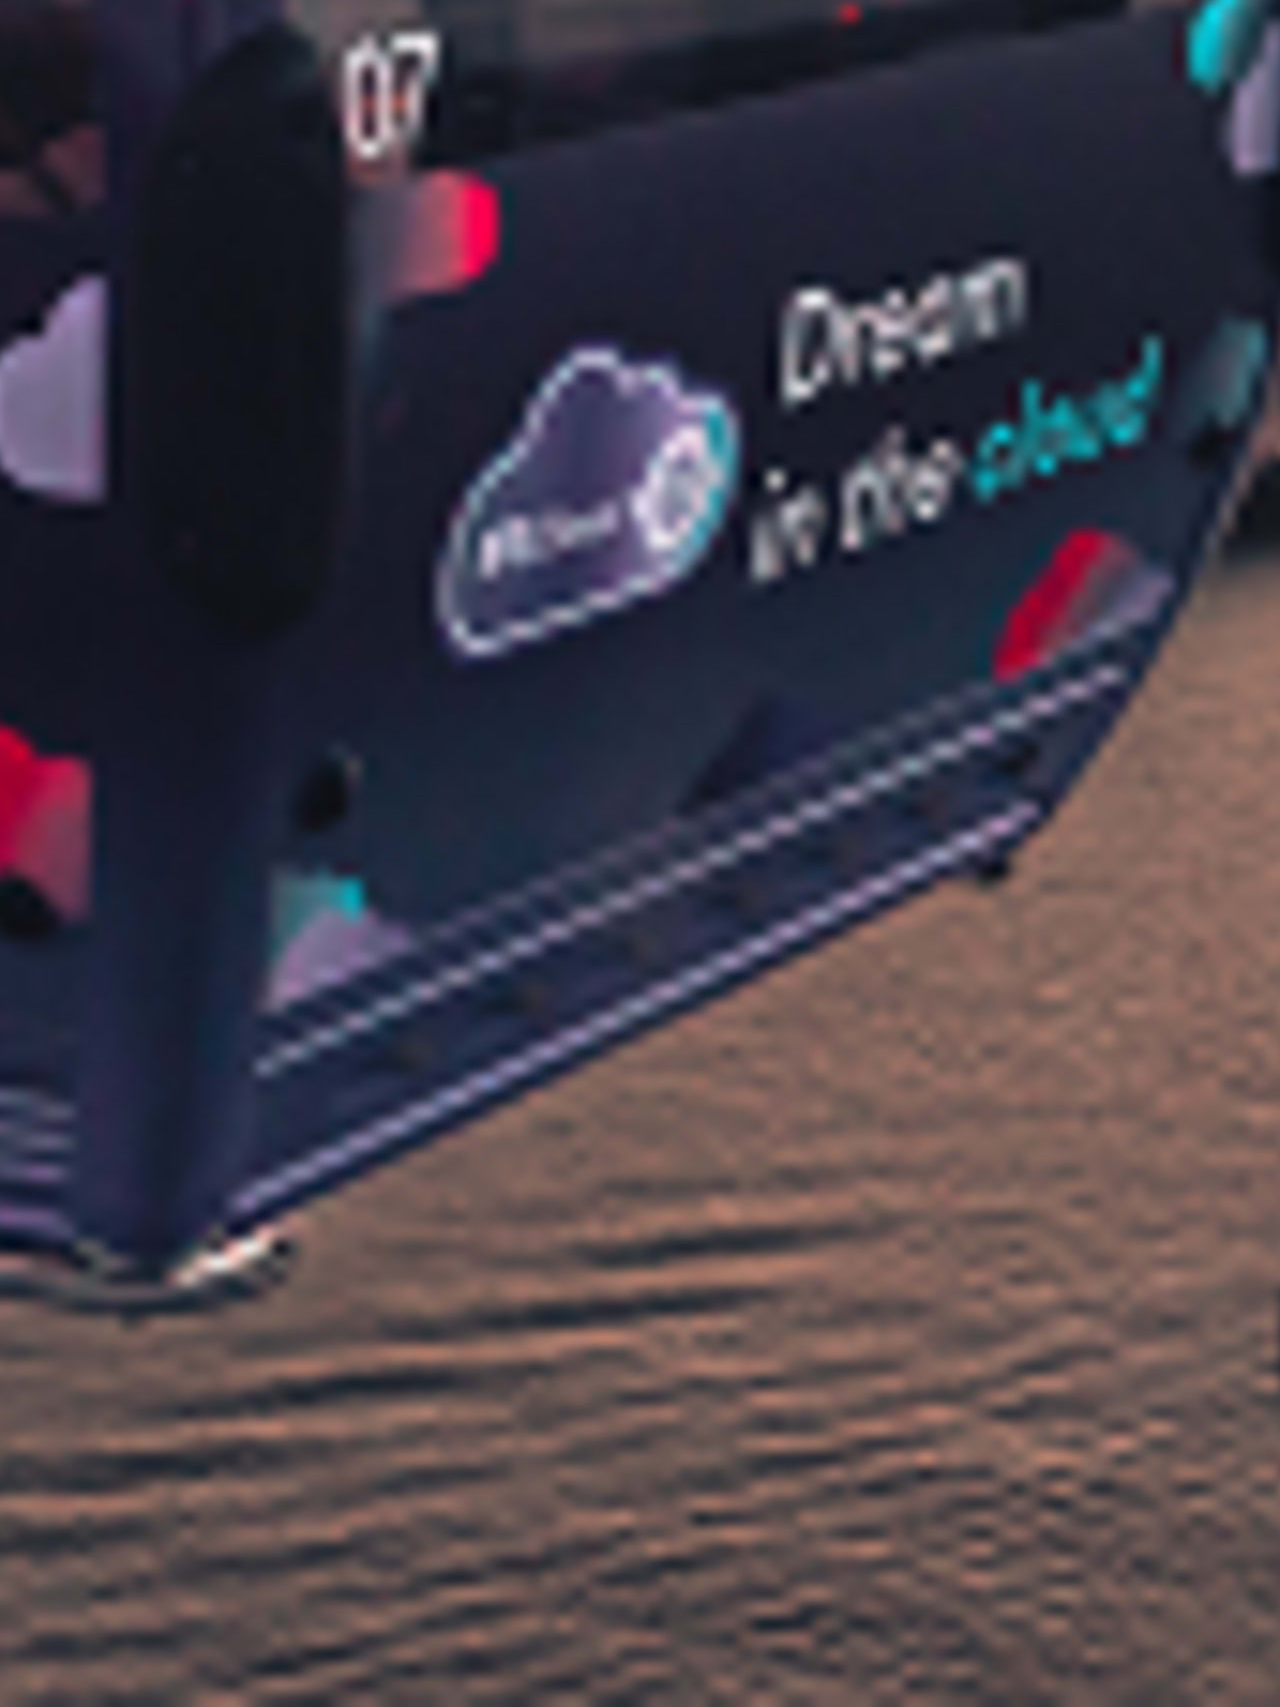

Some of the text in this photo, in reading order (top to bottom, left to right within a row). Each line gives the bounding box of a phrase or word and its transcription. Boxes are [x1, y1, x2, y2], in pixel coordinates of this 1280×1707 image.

[342, 32, 439, 159] 07
[780, 257, 1025, 409] Dream
[749, 467, 825, 583] in
[972, 333, 1163, 499] cloud
